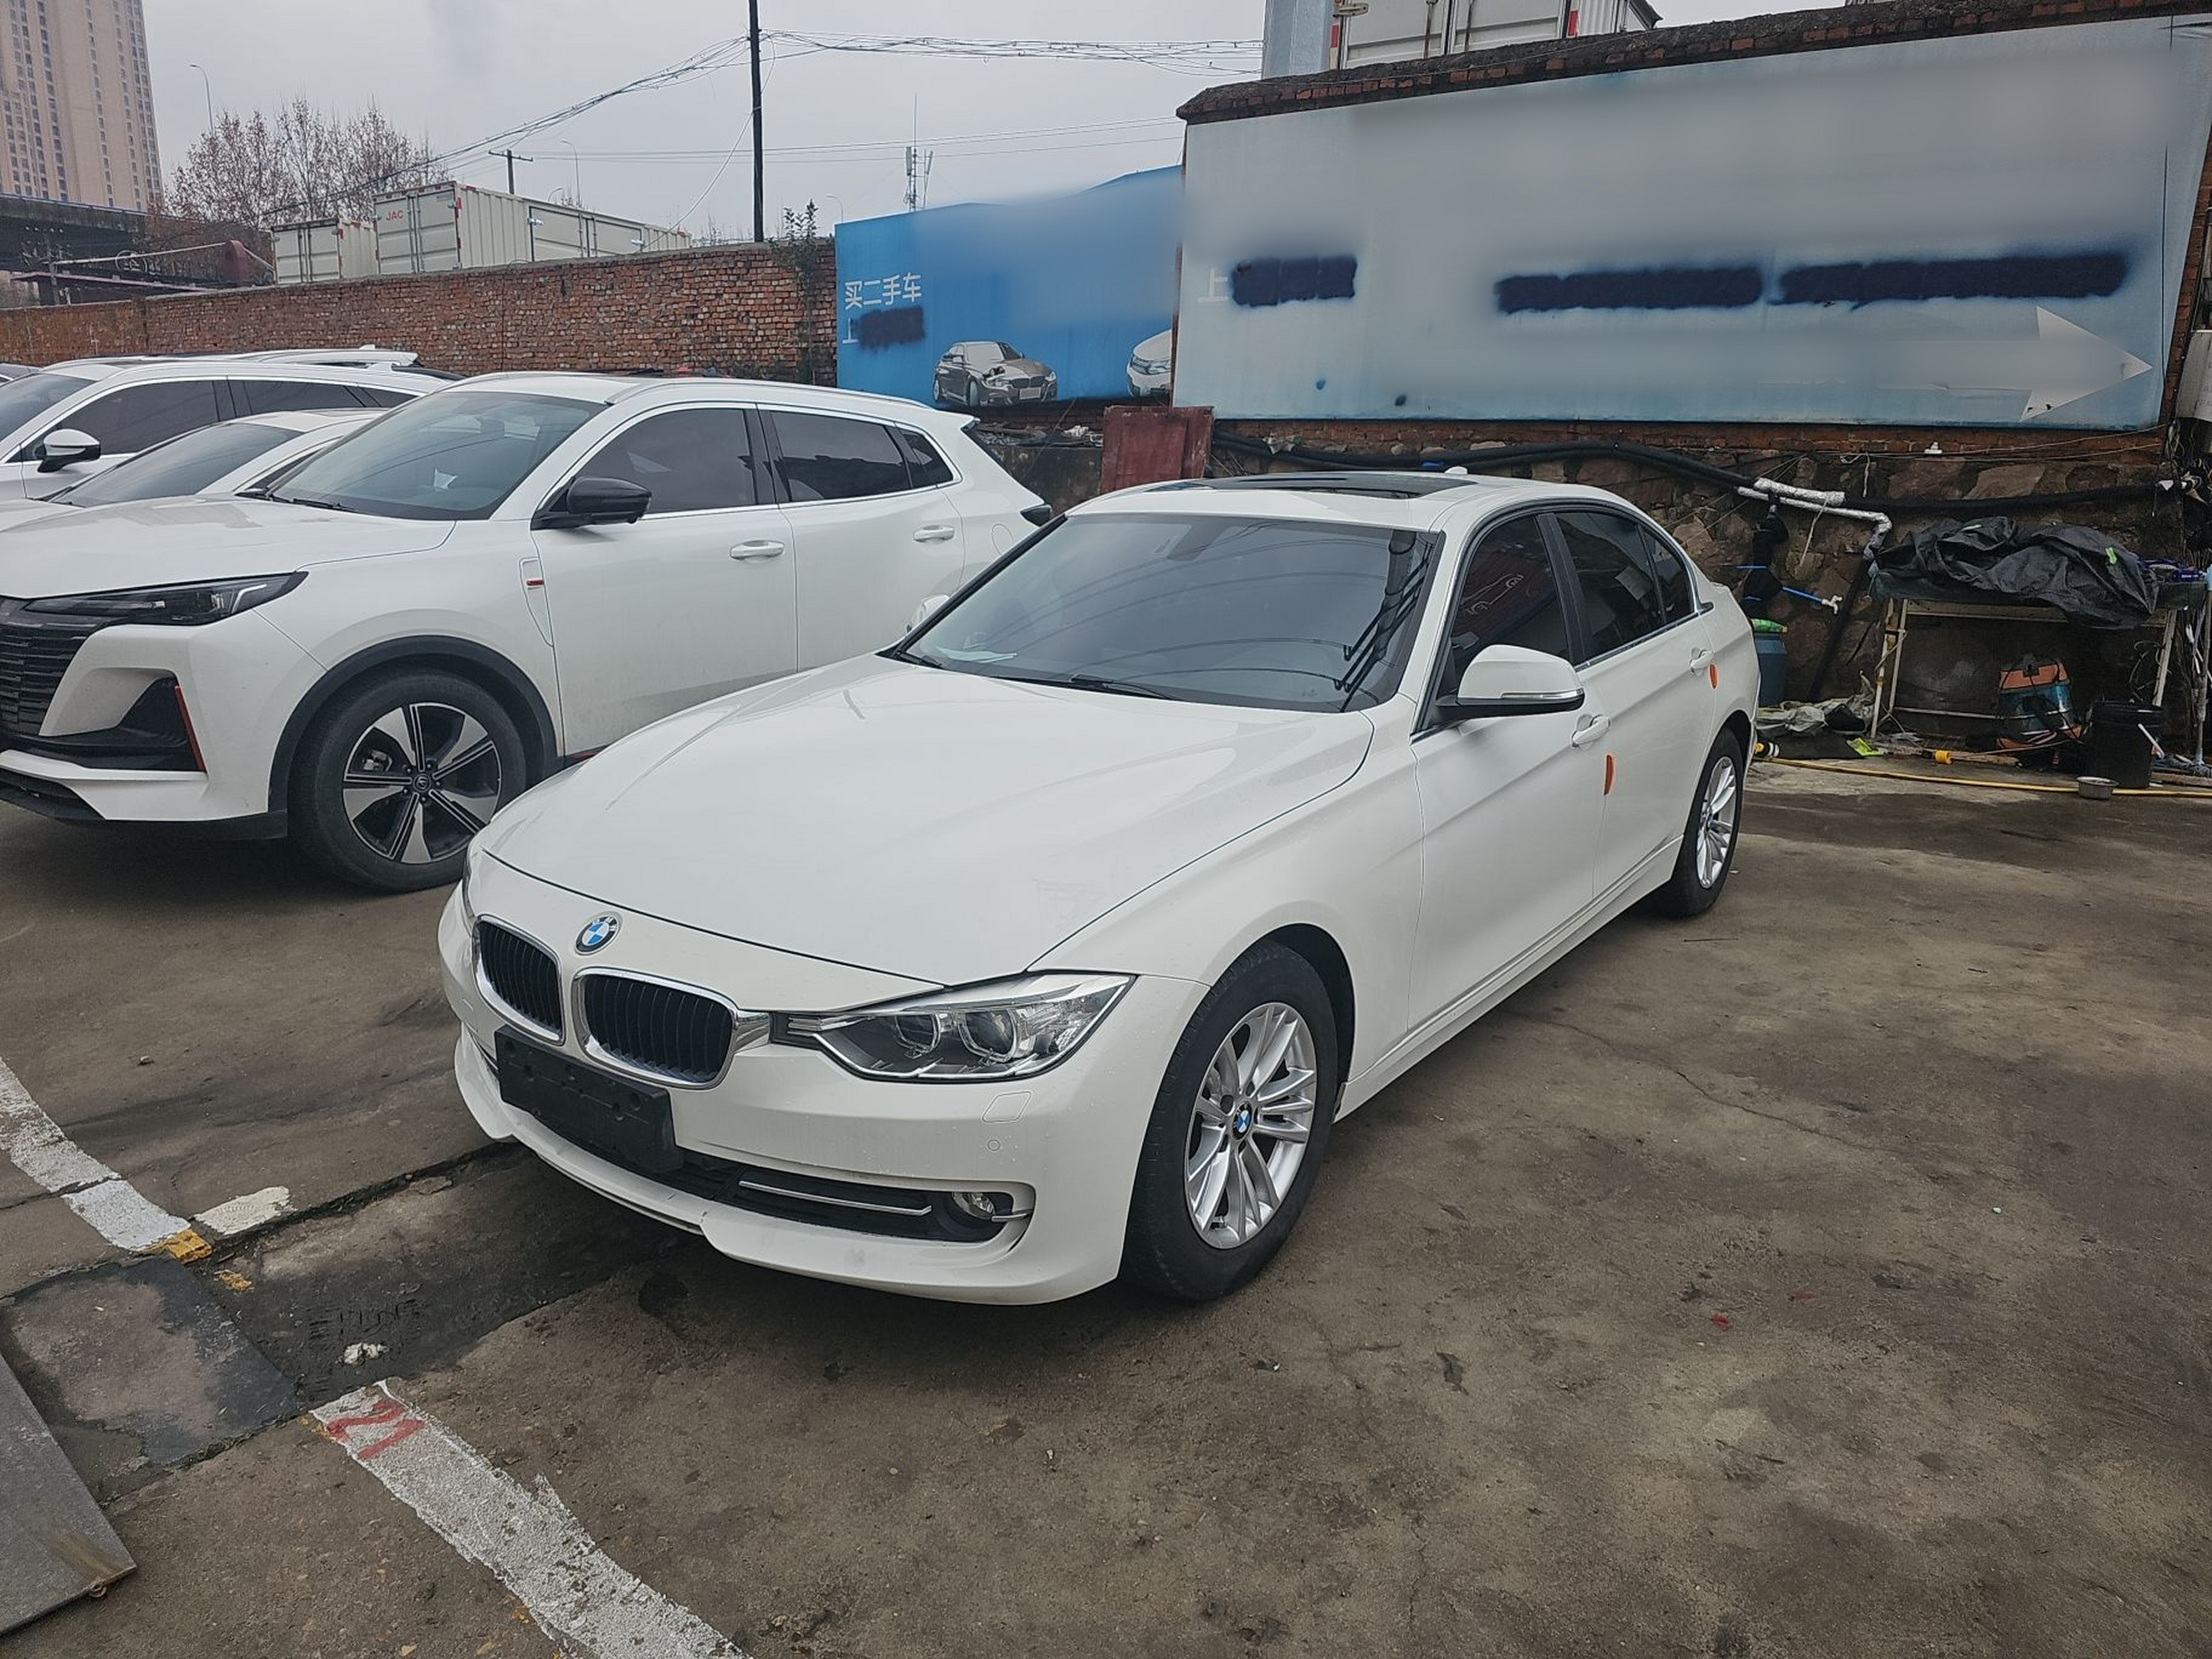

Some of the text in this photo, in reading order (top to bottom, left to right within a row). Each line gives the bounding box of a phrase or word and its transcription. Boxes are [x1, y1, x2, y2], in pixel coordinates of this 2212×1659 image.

[386, 210, 403, 221] JAC
[844, 272, 922, 310] 买二手车
